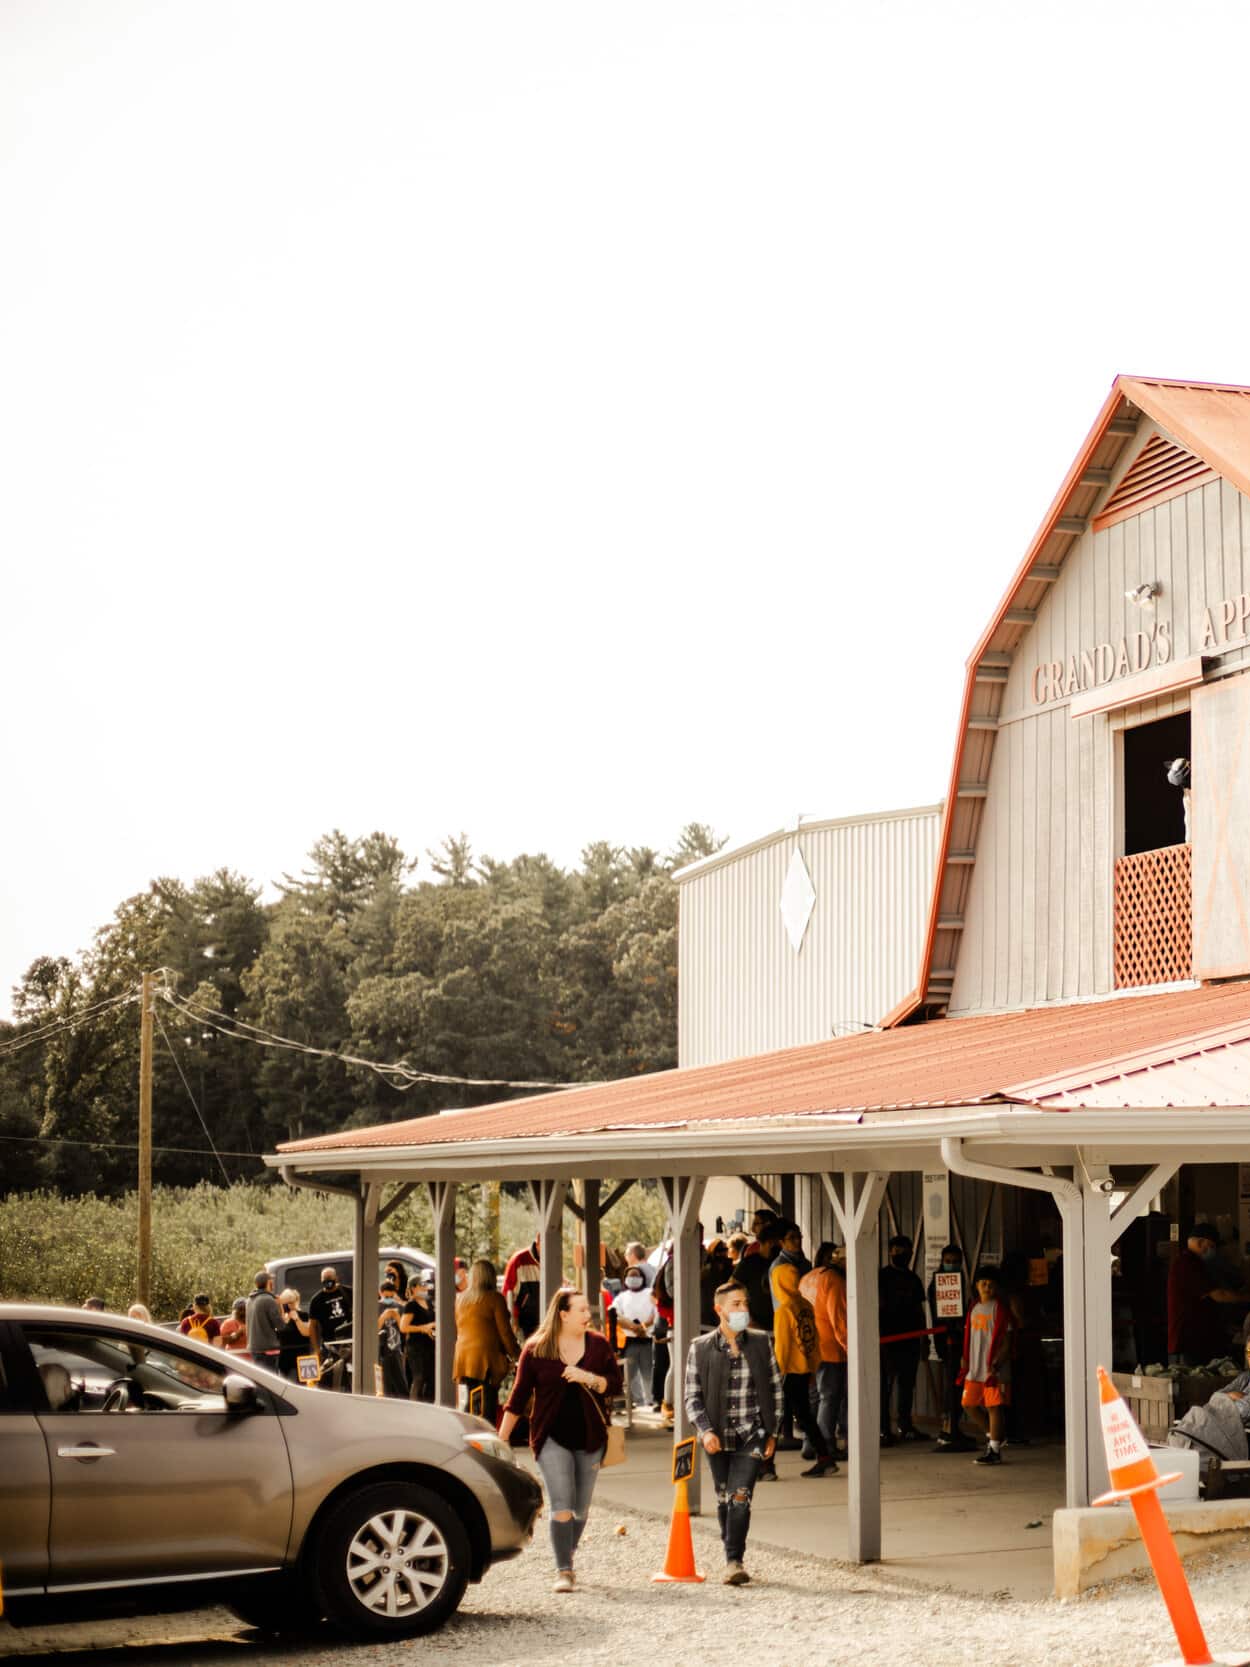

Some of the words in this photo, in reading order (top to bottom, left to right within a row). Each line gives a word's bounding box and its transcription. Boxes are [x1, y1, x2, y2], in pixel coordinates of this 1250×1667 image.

[1031, 619, 1171, 705] GRANDAD'S
[937, 1274, 959, 1287] ENTER
[941, 1303, 958, 1315] HERE
[1114, 1433, 1132, 1447] ANY
[1114, 1442, 1138, 1459] TIME
